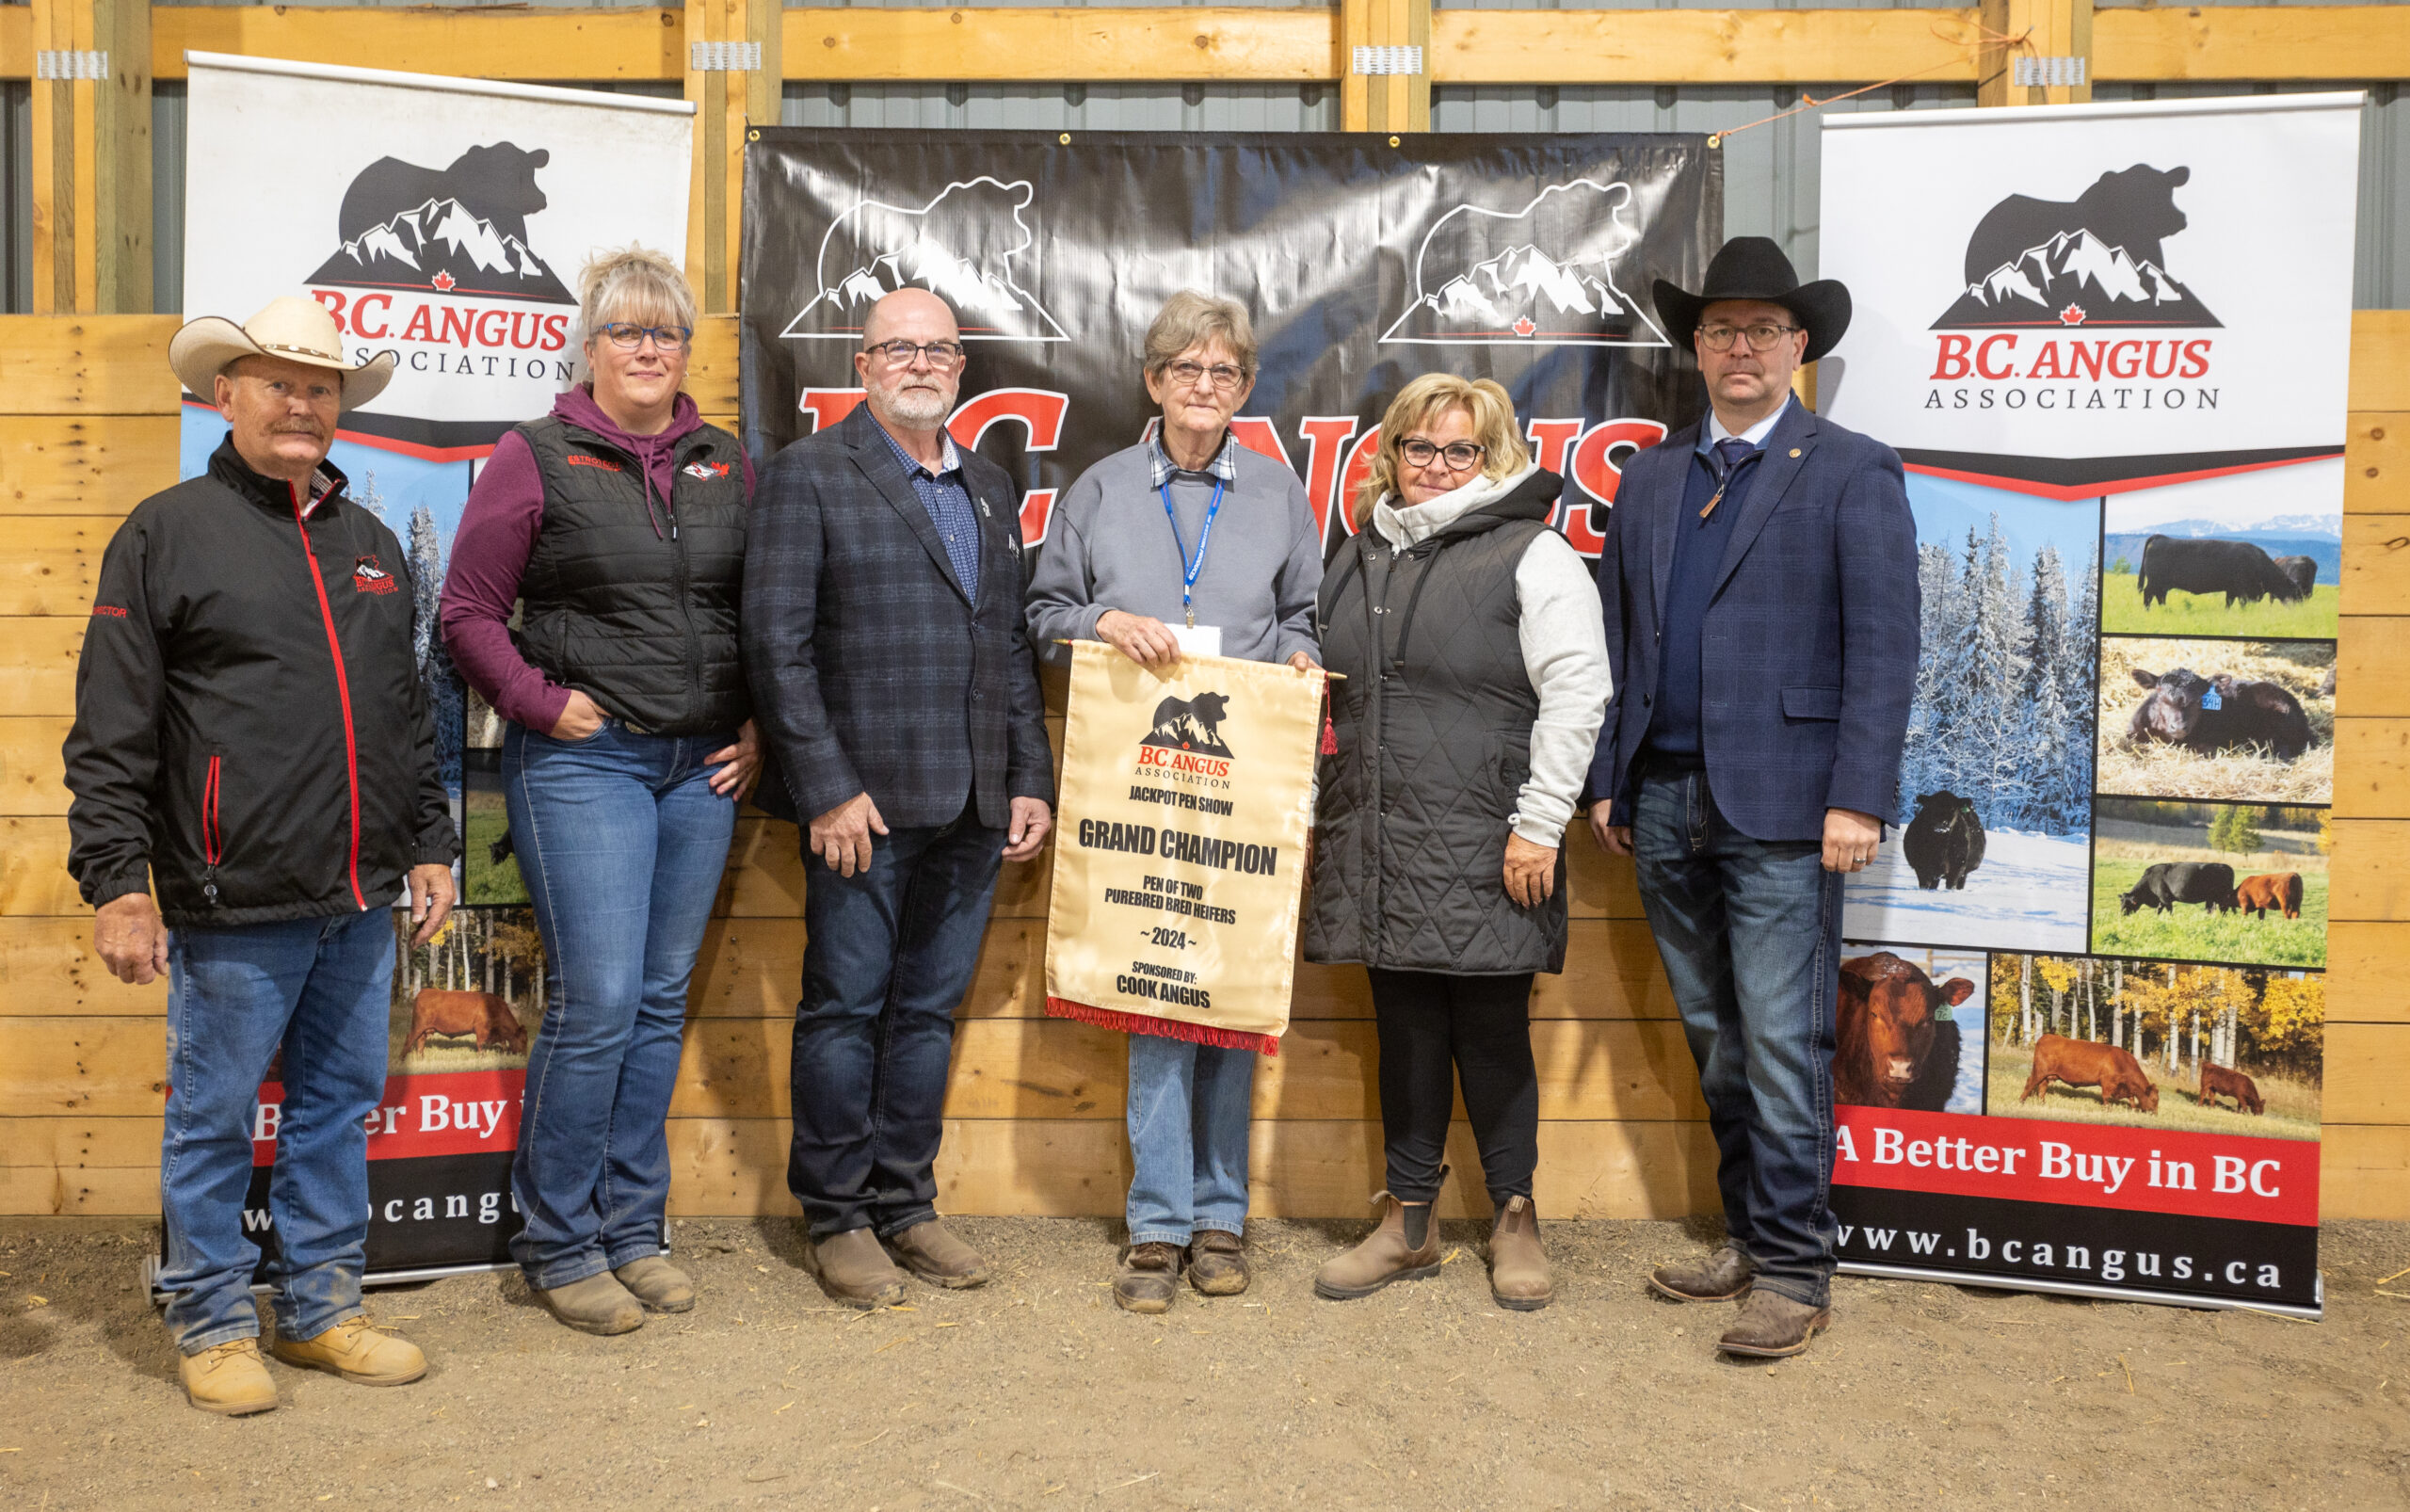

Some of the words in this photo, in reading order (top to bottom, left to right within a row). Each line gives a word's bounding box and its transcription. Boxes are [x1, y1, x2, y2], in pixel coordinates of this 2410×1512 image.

[400, 304, 570, 351] ANGUS
[341, 346, 576, 382] SCIATION
[1929, 333, 2021, 381] B.C.
[2026, 339, 2214, 382] ANGUS
[1924, 388, 2220, 410] ASSOCIATION
[1134, 766, 1231, 790] ASSOCIATION
[1137, 746, 1170, 767] B.C.
[1170, 753, 1230, 777] ANGUS
[1129, 785, 1178, 806] JACKPOT
[1178, 793, 1197, 811] PEN
[1197, 796, 1234, 816] SHOW
[1079, 818, 1156, 855] GRAND
[1160, 828, 1278, 877] CHAMPION
[1142, 875, 1165, 893] PEN
[1165, 878, 1179, 894] OF
[1180, 881, 1203, 900] TWO
[1104, 888, 1164, 910] PUREBRED
[1165, 897, 1192, 916] BRED
[1193, 902, 1236, 925] HEIFERS
[1132, 960, 1183, 981] SPONSORED
[1183, 971, 1197, 986] BY:
[1117, 974, 1158, 1000] COOK
[1159, 982, 1211, 1009] ANGUS
[419, 1094, 508, 1139] Buy
[1837, 1125, 1860, 1162] A
[1872, 1127, 2026, 1175] Better
[2039, 1141, 2136, 1194] Buy
[2147, 1150, 2197, 1191] in
[2212, 1155, 2281, 1198] BC
